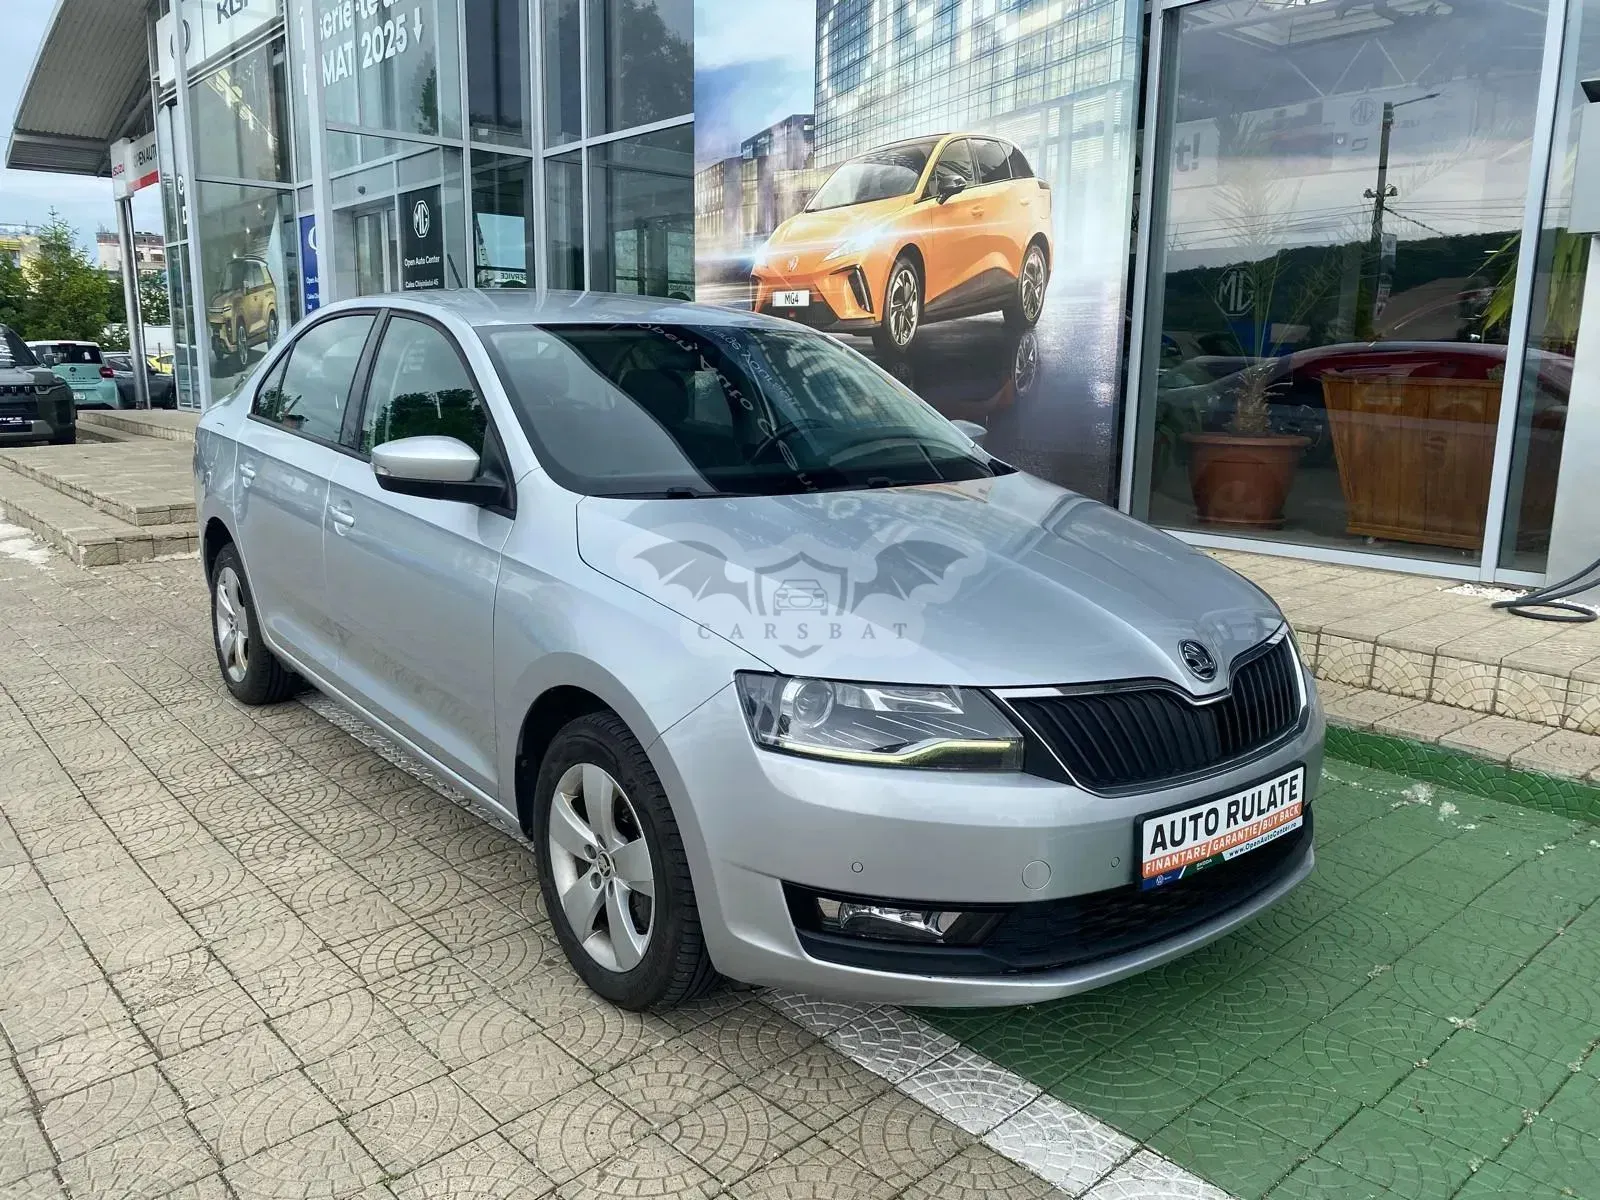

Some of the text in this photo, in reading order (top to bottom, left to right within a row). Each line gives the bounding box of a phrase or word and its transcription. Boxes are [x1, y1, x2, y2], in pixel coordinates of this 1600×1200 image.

[361, 13, 407, 68] 2025
[414, 201, 429, 237] MG
[404, 255, 440, 268] Open Auto Center
[784, 292, 799, 305] MG4
[1150, 774, 1299, 855] AUTO RULATE
[1279, 805, 1300, 821] BACK
[1229, 822, 1297, 858] www.OpenAutoCenter.ro
